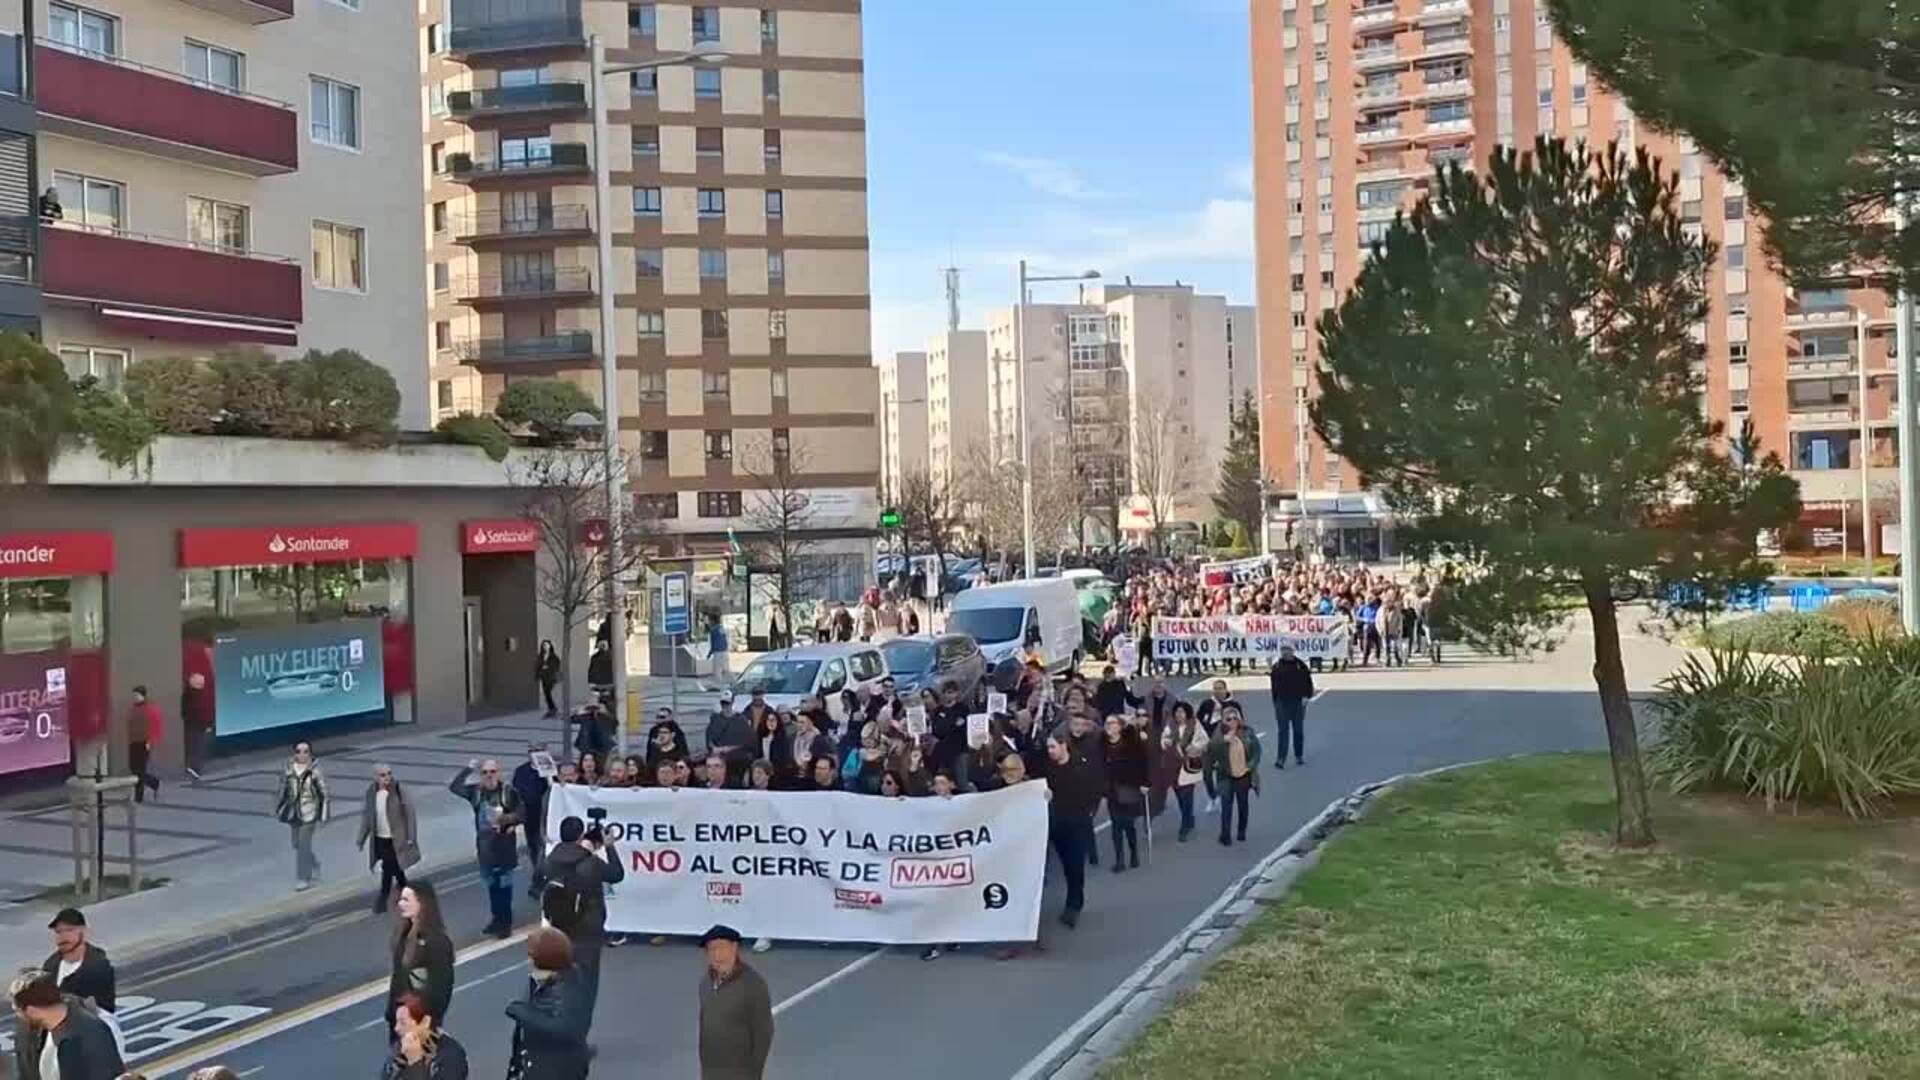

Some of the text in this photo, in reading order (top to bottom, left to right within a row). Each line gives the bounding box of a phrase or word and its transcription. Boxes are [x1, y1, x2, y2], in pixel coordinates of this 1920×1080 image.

[287, 537, 350, 552] Santander
[1246, 617, 1277, 633] NAHI
[1289, 617, 1325, 633] DUGU
[1217, 637, 1247, 651] PARA
[1255, 635, 1330, 651] SUNSNDEGUI
[241, 644, 352, 680] MUY FUERT
[37, 712, 51, 738] 0
[653, 823, 685, 842] EL
[695, 823, 807, 845] EMPLEO
[818, 828, 836, 847] Y
[846, 830, 878, 851] LA
[889, 825, 992, 853] RIBERA
[632, 850, 967, 883] NO AL CIERRE DE NANO
[114, 995, 272, 1063] BU
